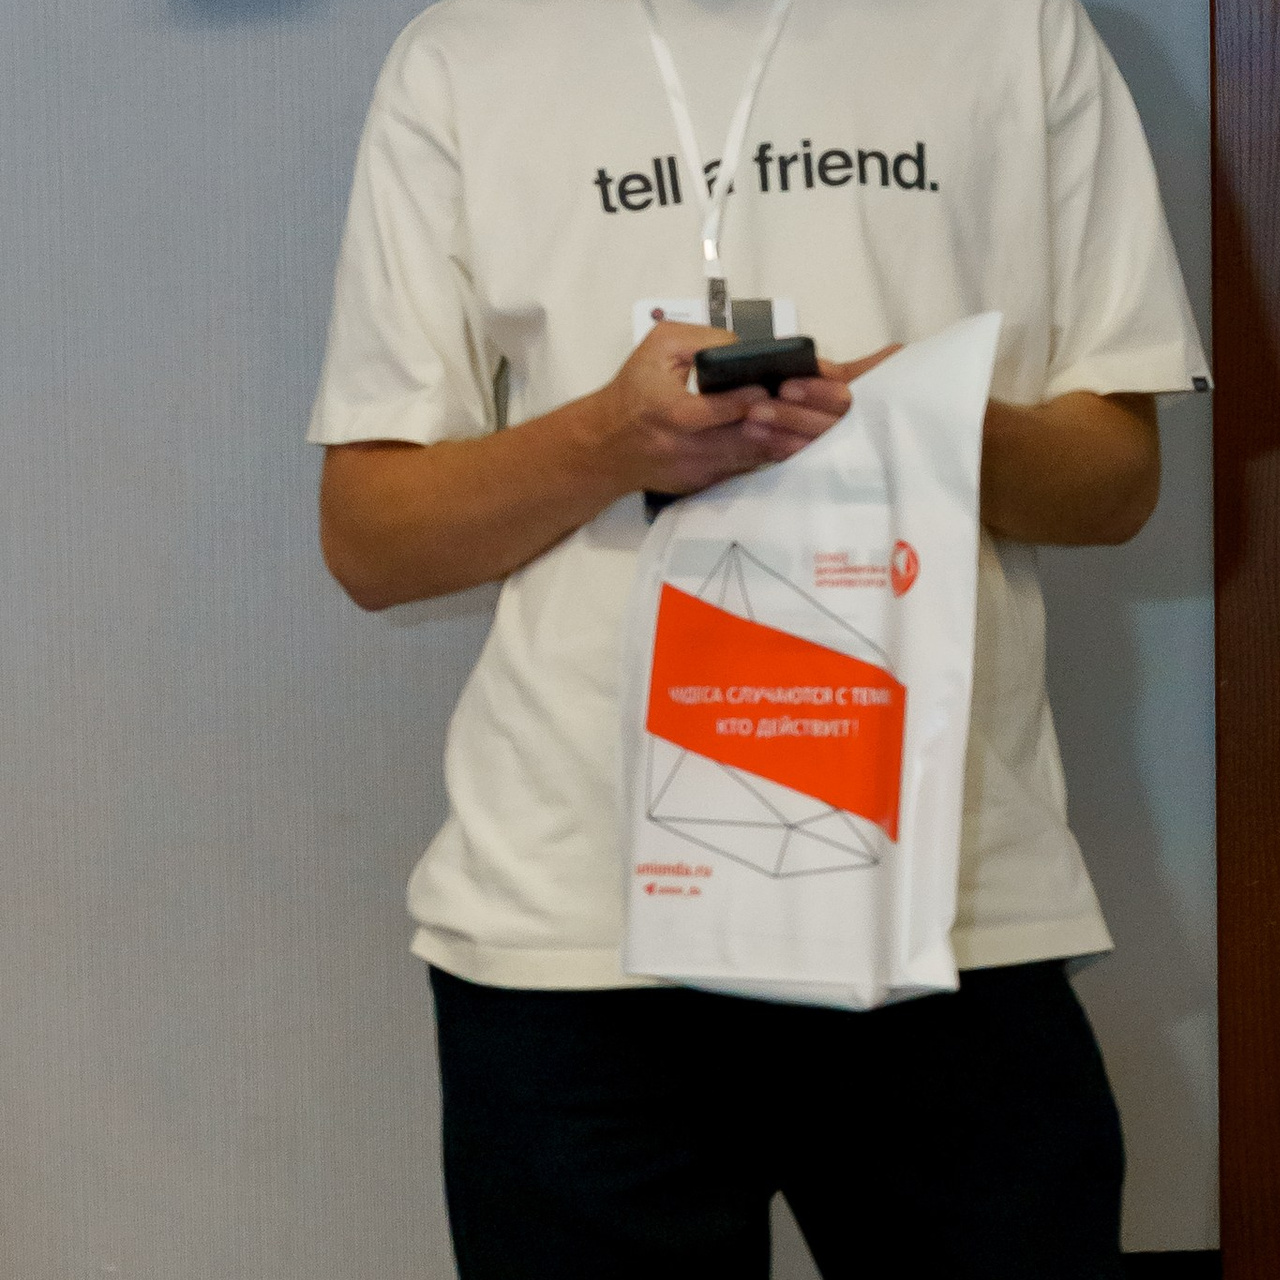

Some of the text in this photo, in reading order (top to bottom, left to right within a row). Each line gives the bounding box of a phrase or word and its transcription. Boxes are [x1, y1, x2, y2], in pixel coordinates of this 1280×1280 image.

[594, 156, 682, 213] tell
[753, 139, 938, 192] friend.
[835, 687, 848, 706] С
[716, 718, 754, 736] КТО
